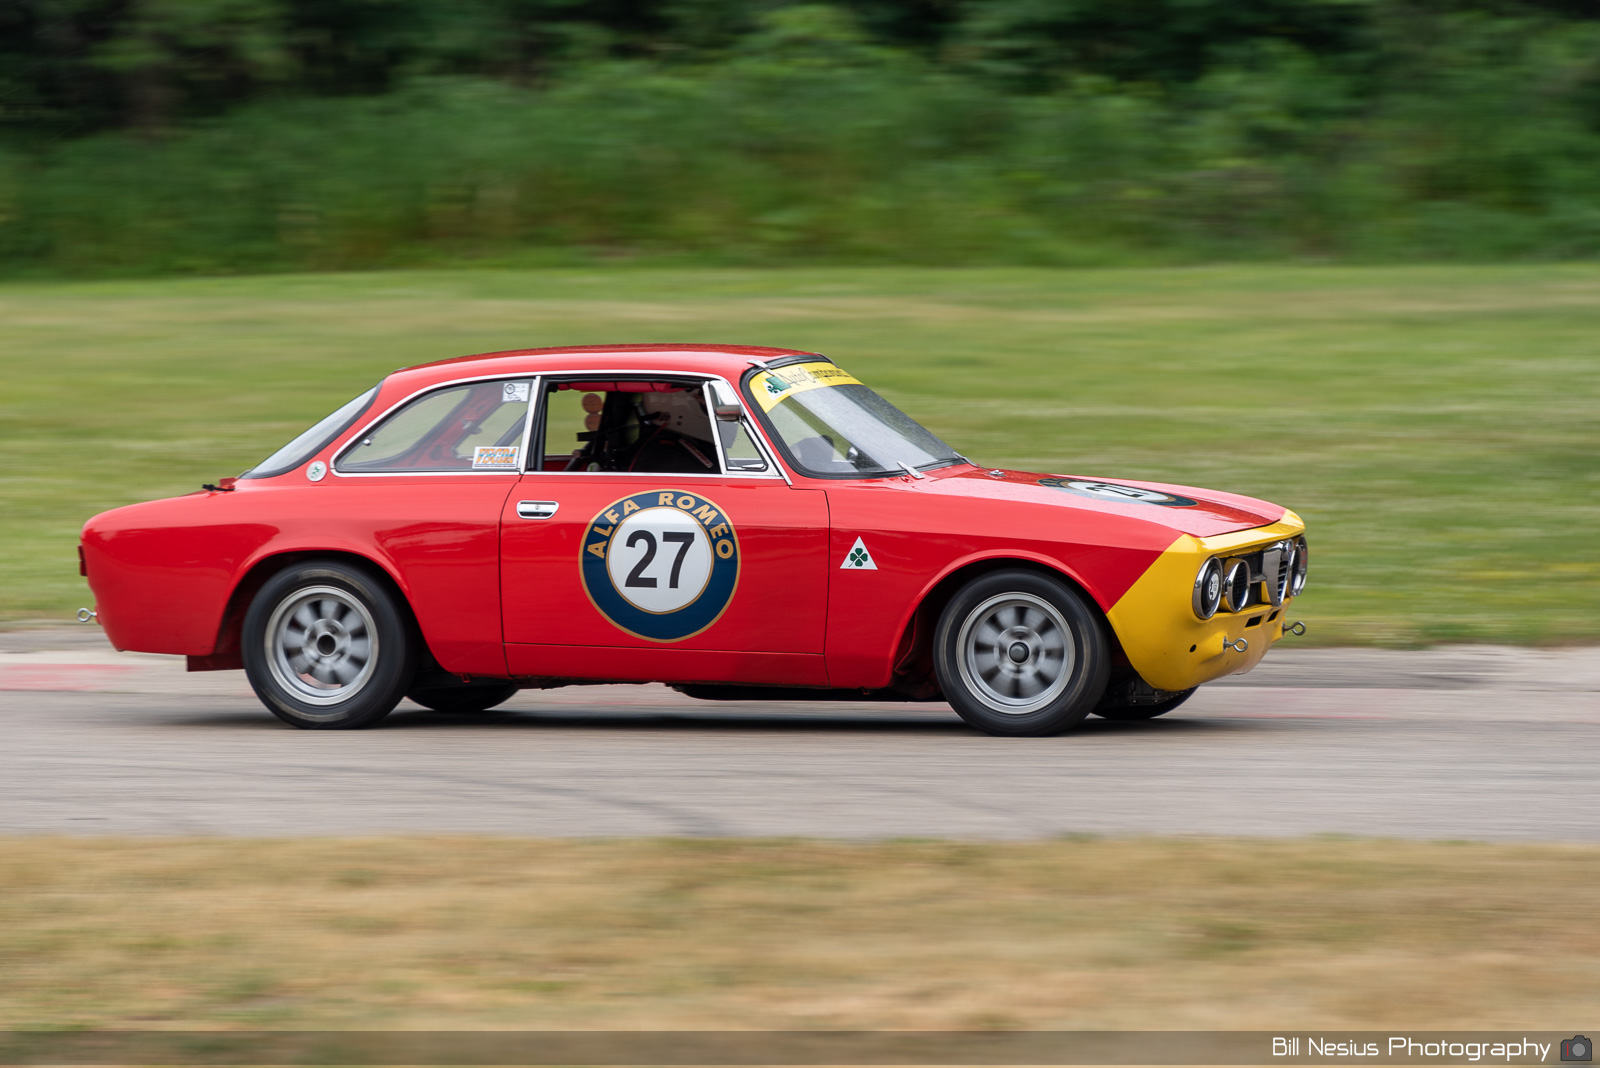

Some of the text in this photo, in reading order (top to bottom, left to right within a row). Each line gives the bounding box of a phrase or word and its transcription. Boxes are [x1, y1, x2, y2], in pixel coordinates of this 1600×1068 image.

[587, 492, 734, 559] ALFA ROMEO
[624, 529, 695, 589] 27
